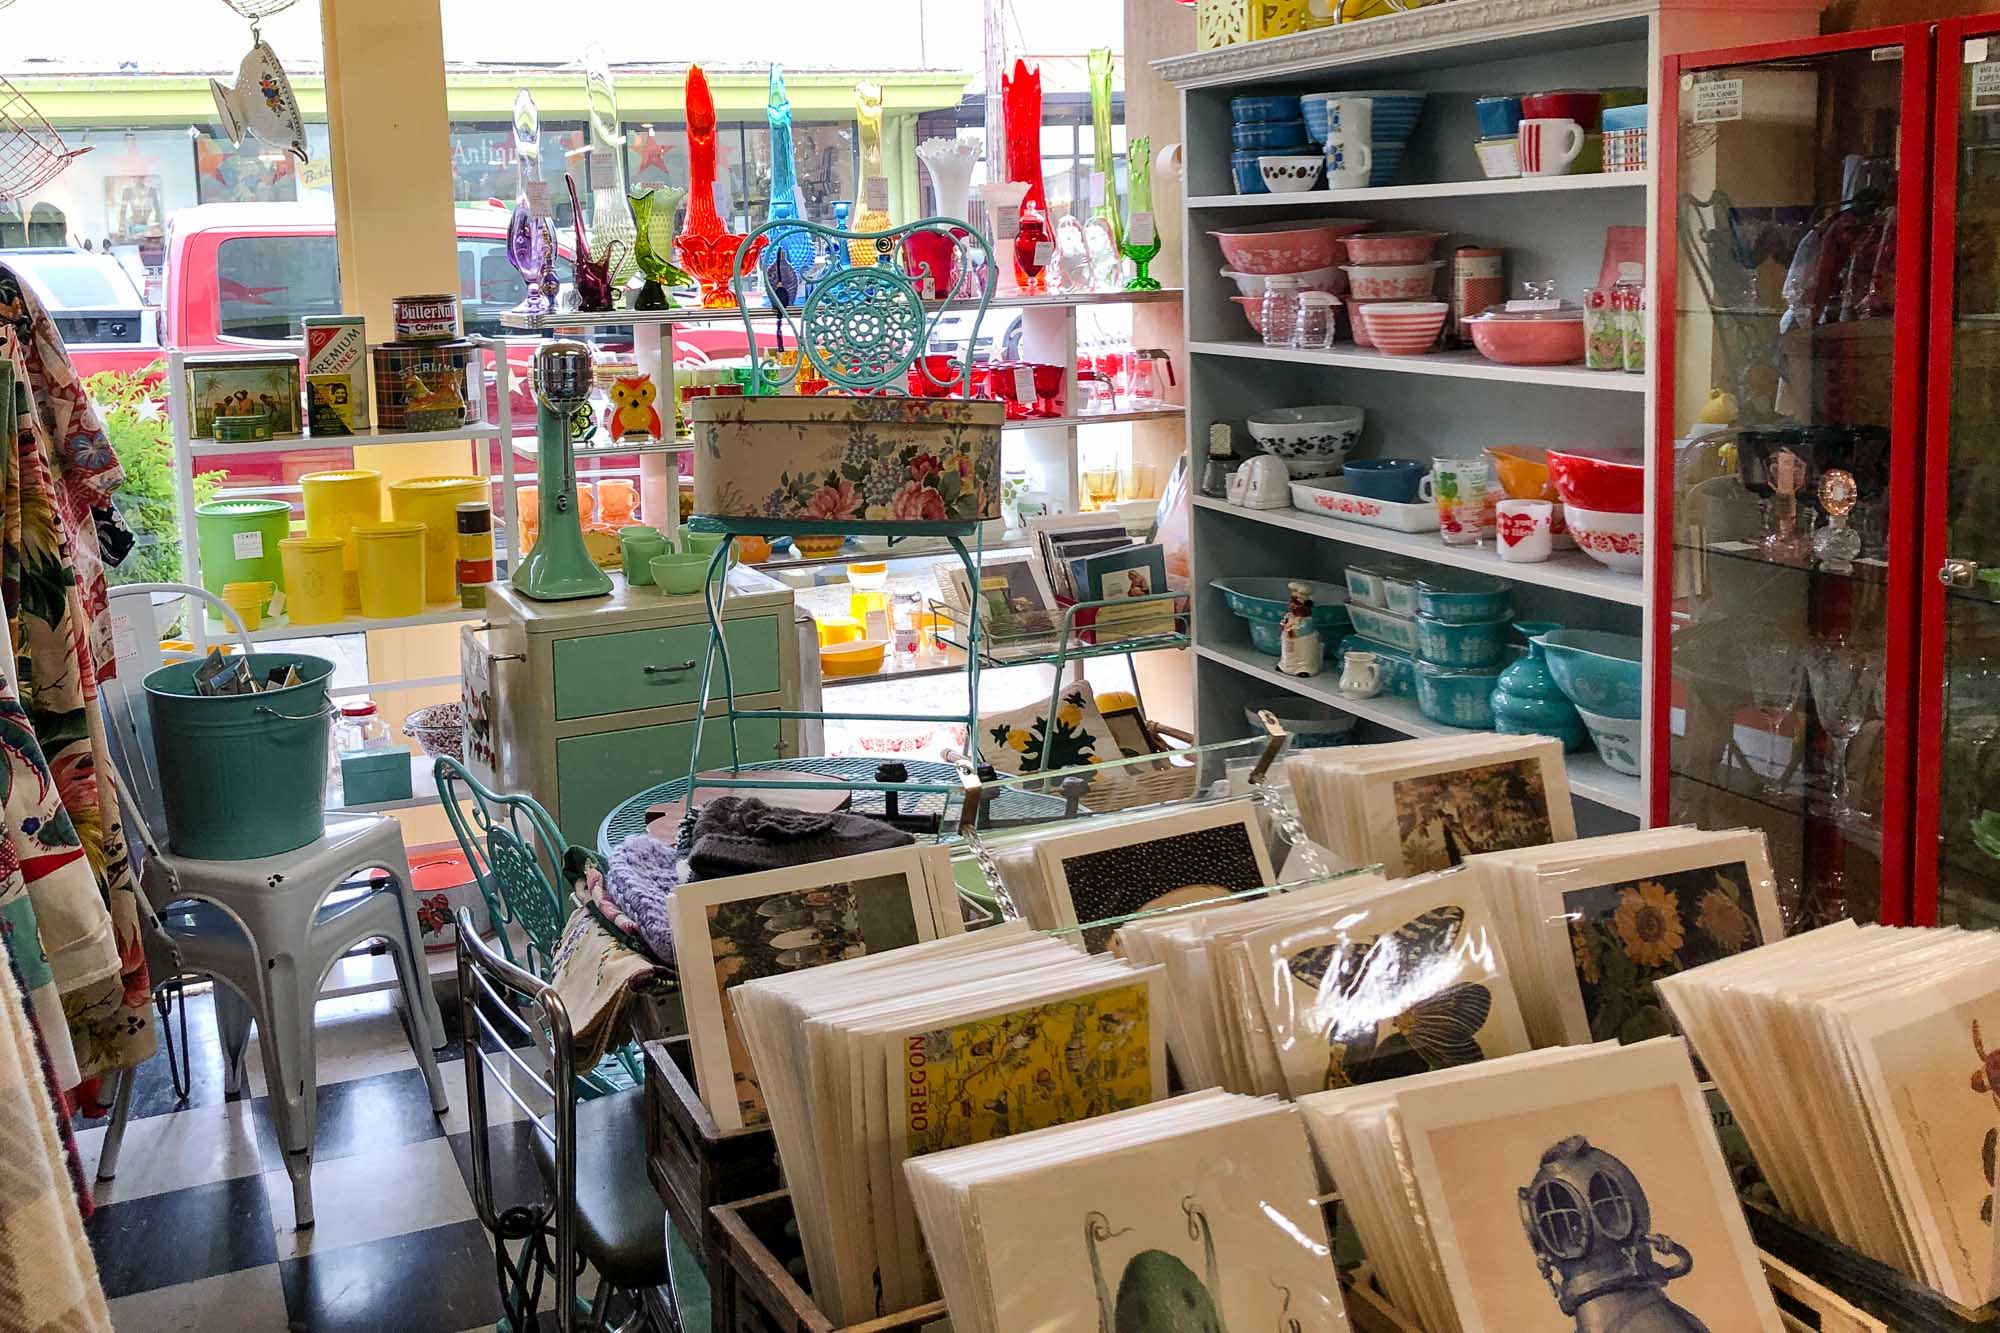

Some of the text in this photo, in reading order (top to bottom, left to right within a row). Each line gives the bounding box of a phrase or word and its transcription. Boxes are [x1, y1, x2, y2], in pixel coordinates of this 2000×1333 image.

[415, 323, 444, 332] Coffee
[310, 328, 361, 374] PREMIUM
[330, 346, 358, 374] TINES
[909, 1036, 928, 1131] OREGON
